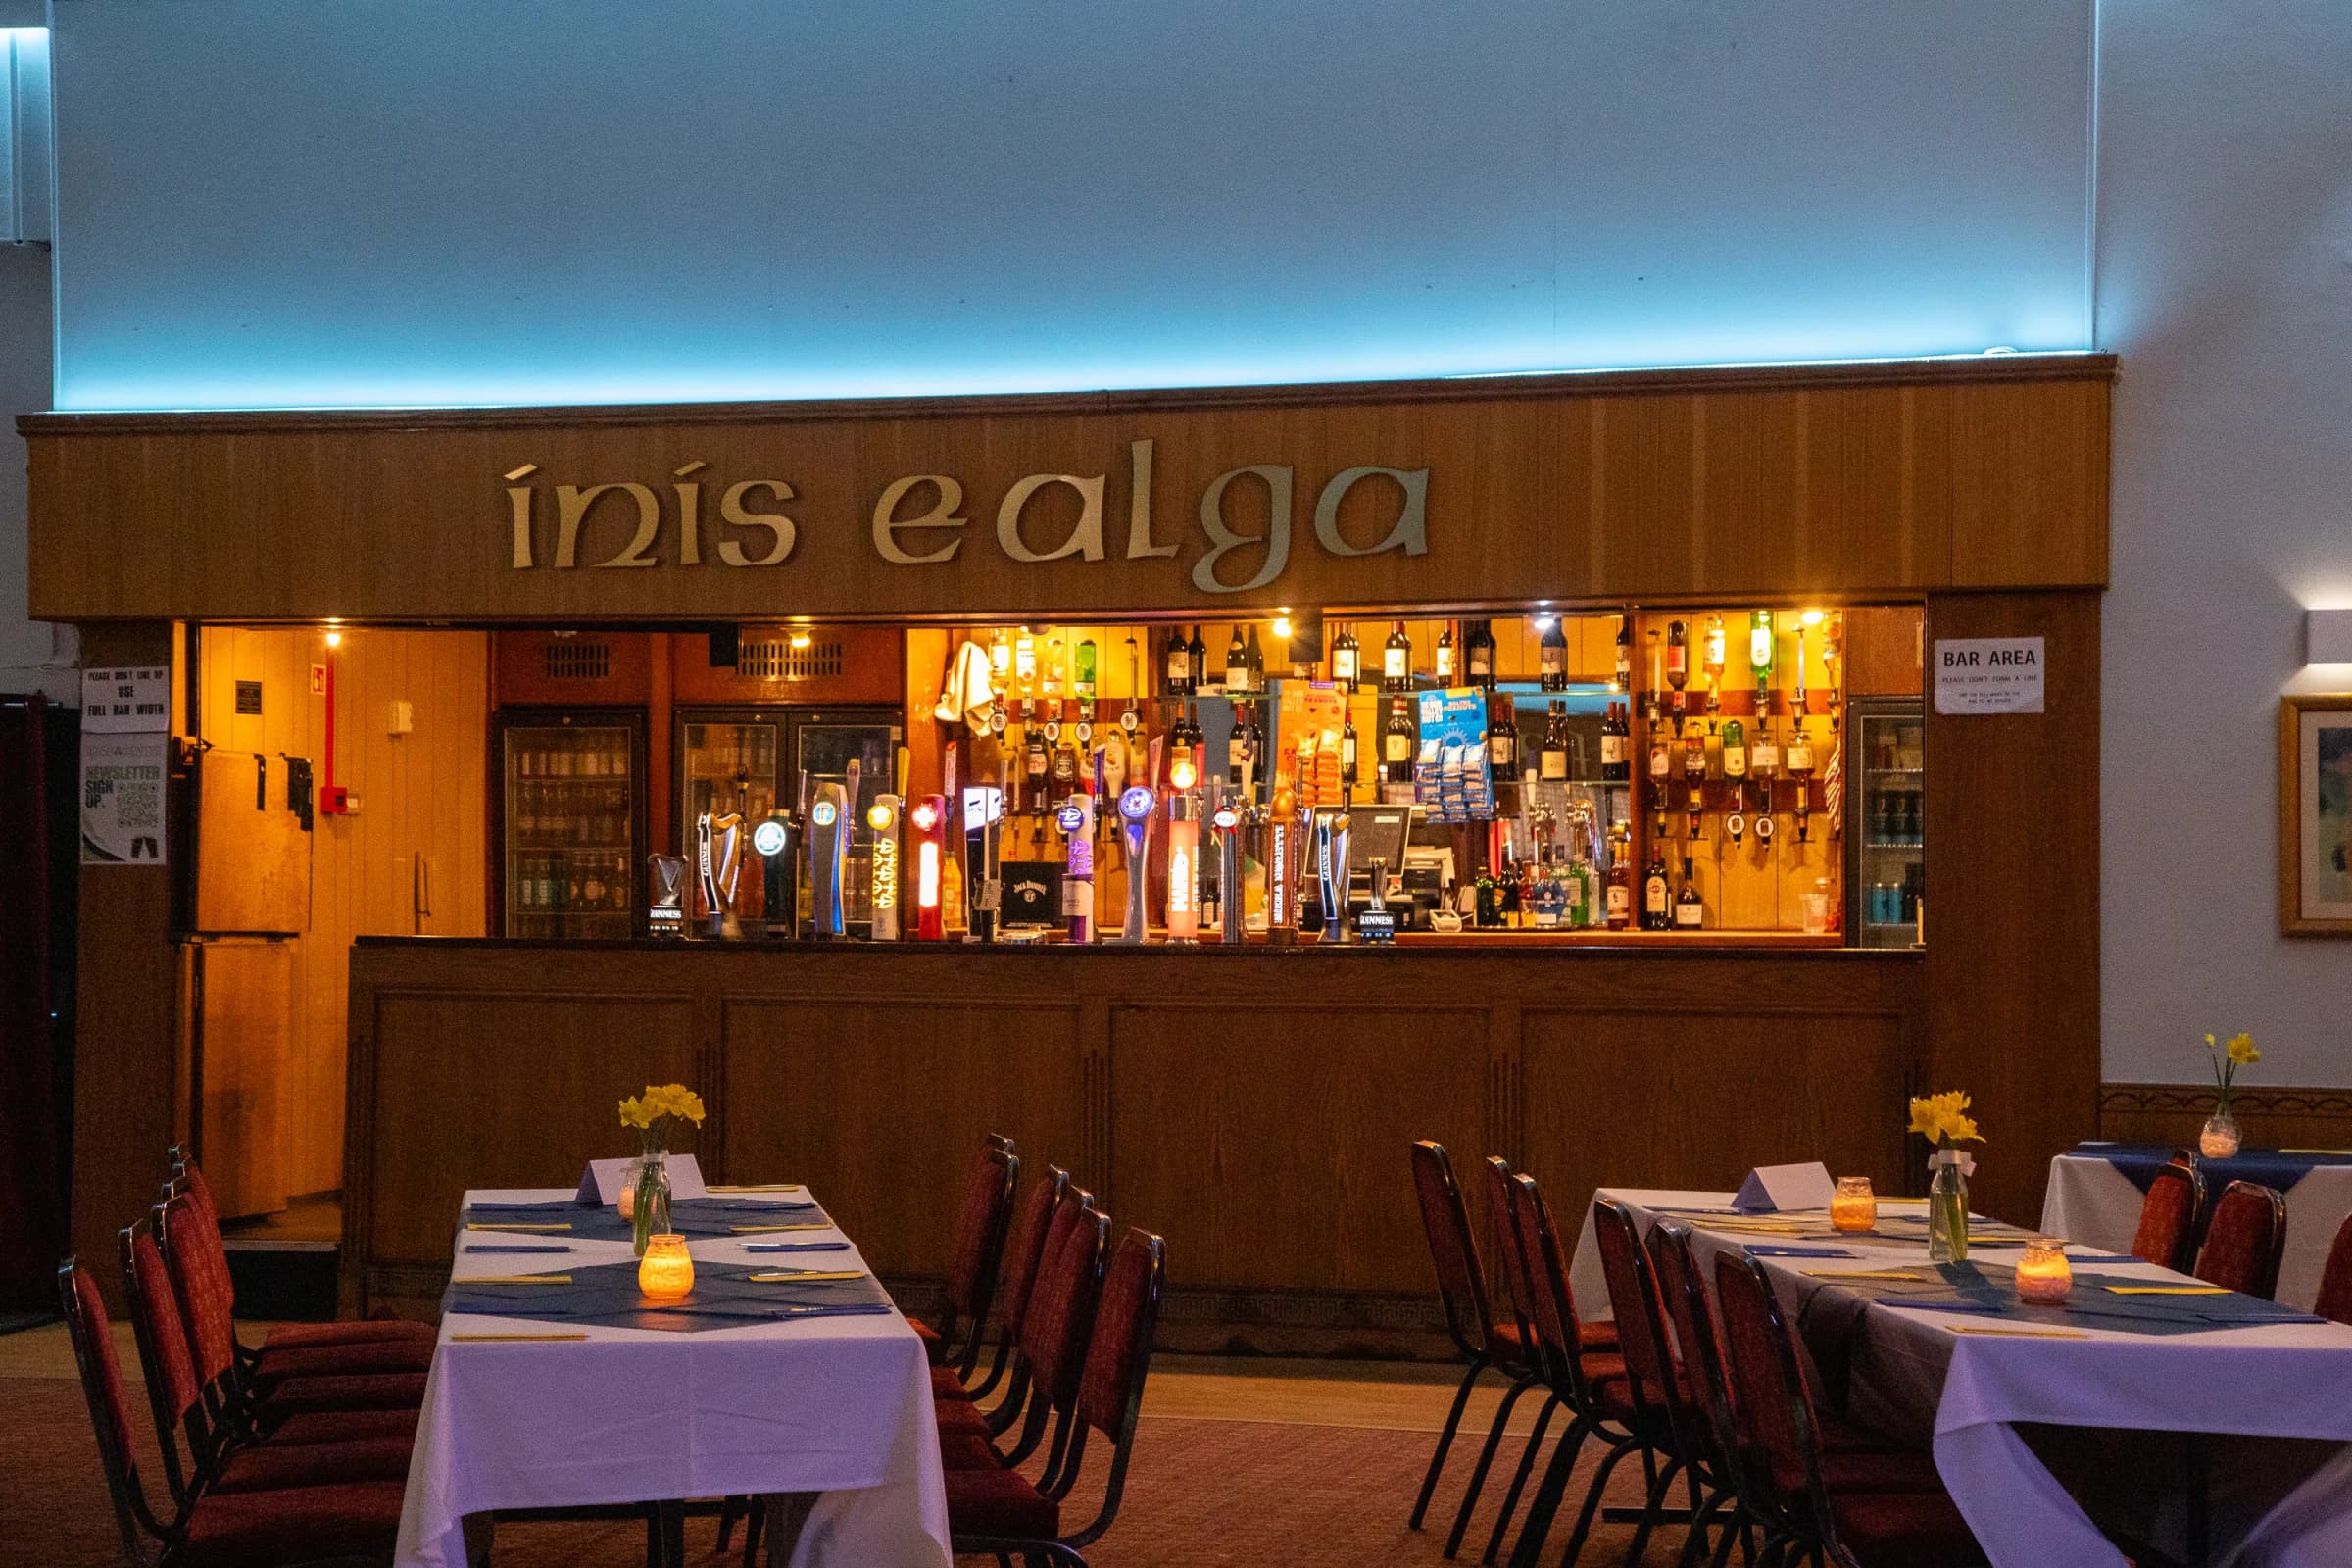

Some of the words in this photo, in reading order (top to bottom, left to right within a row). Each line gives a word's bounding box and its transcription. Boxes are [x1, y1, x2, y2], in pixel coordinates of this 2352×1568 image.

[1943, 651, 1980, 667] BAR
[1988, 650, 2036, 666] AREA
[1969, 674, 1988, 683] DON'T
[118, 686, 134, 698] USE
[88, 705, 106, 716] FULL
[113, 705, 130, 715] BAR
[136, 704, 164, 715] WIDTH
[86, 765, 160, 780] NEWSLETTER
[85, 780, 113, 794] SIGN
